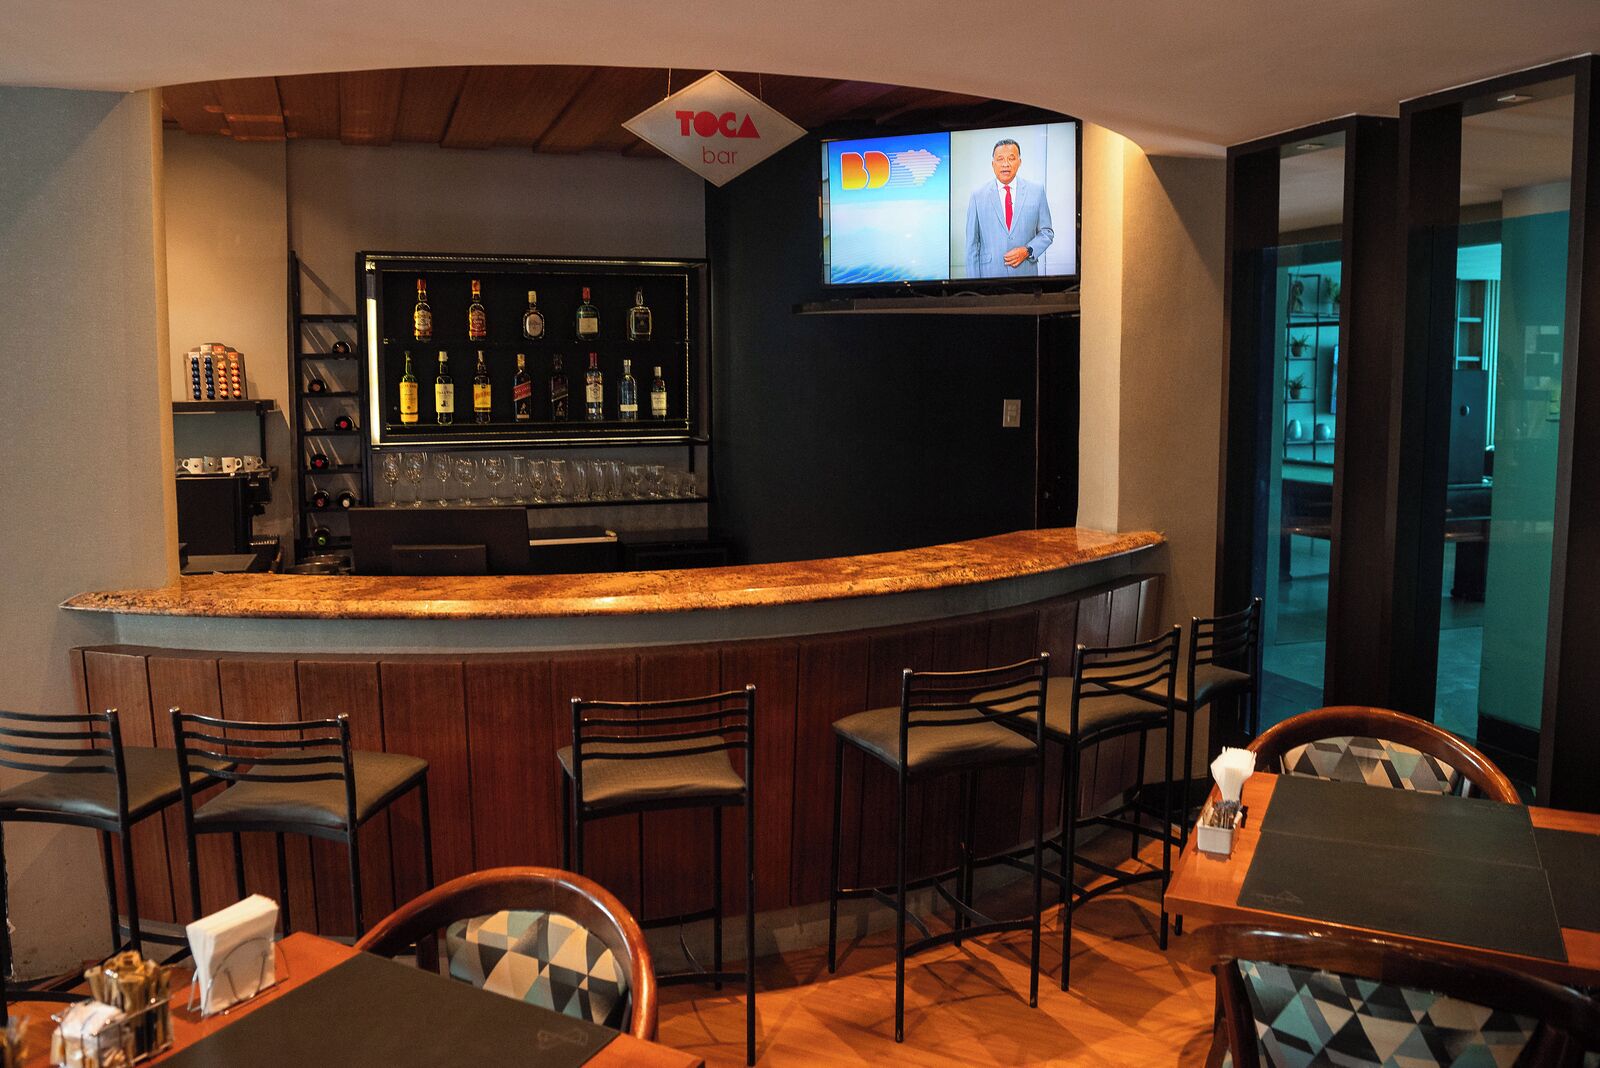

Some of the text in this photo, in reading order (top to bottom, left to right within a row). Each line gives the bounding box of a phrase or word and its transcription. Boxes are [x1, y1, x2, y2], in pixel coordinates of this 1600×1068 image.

[676, 111, 761, 139] TOCA
[702, 146, 738, 165] bar
[840, 150, 890, 190] BD
